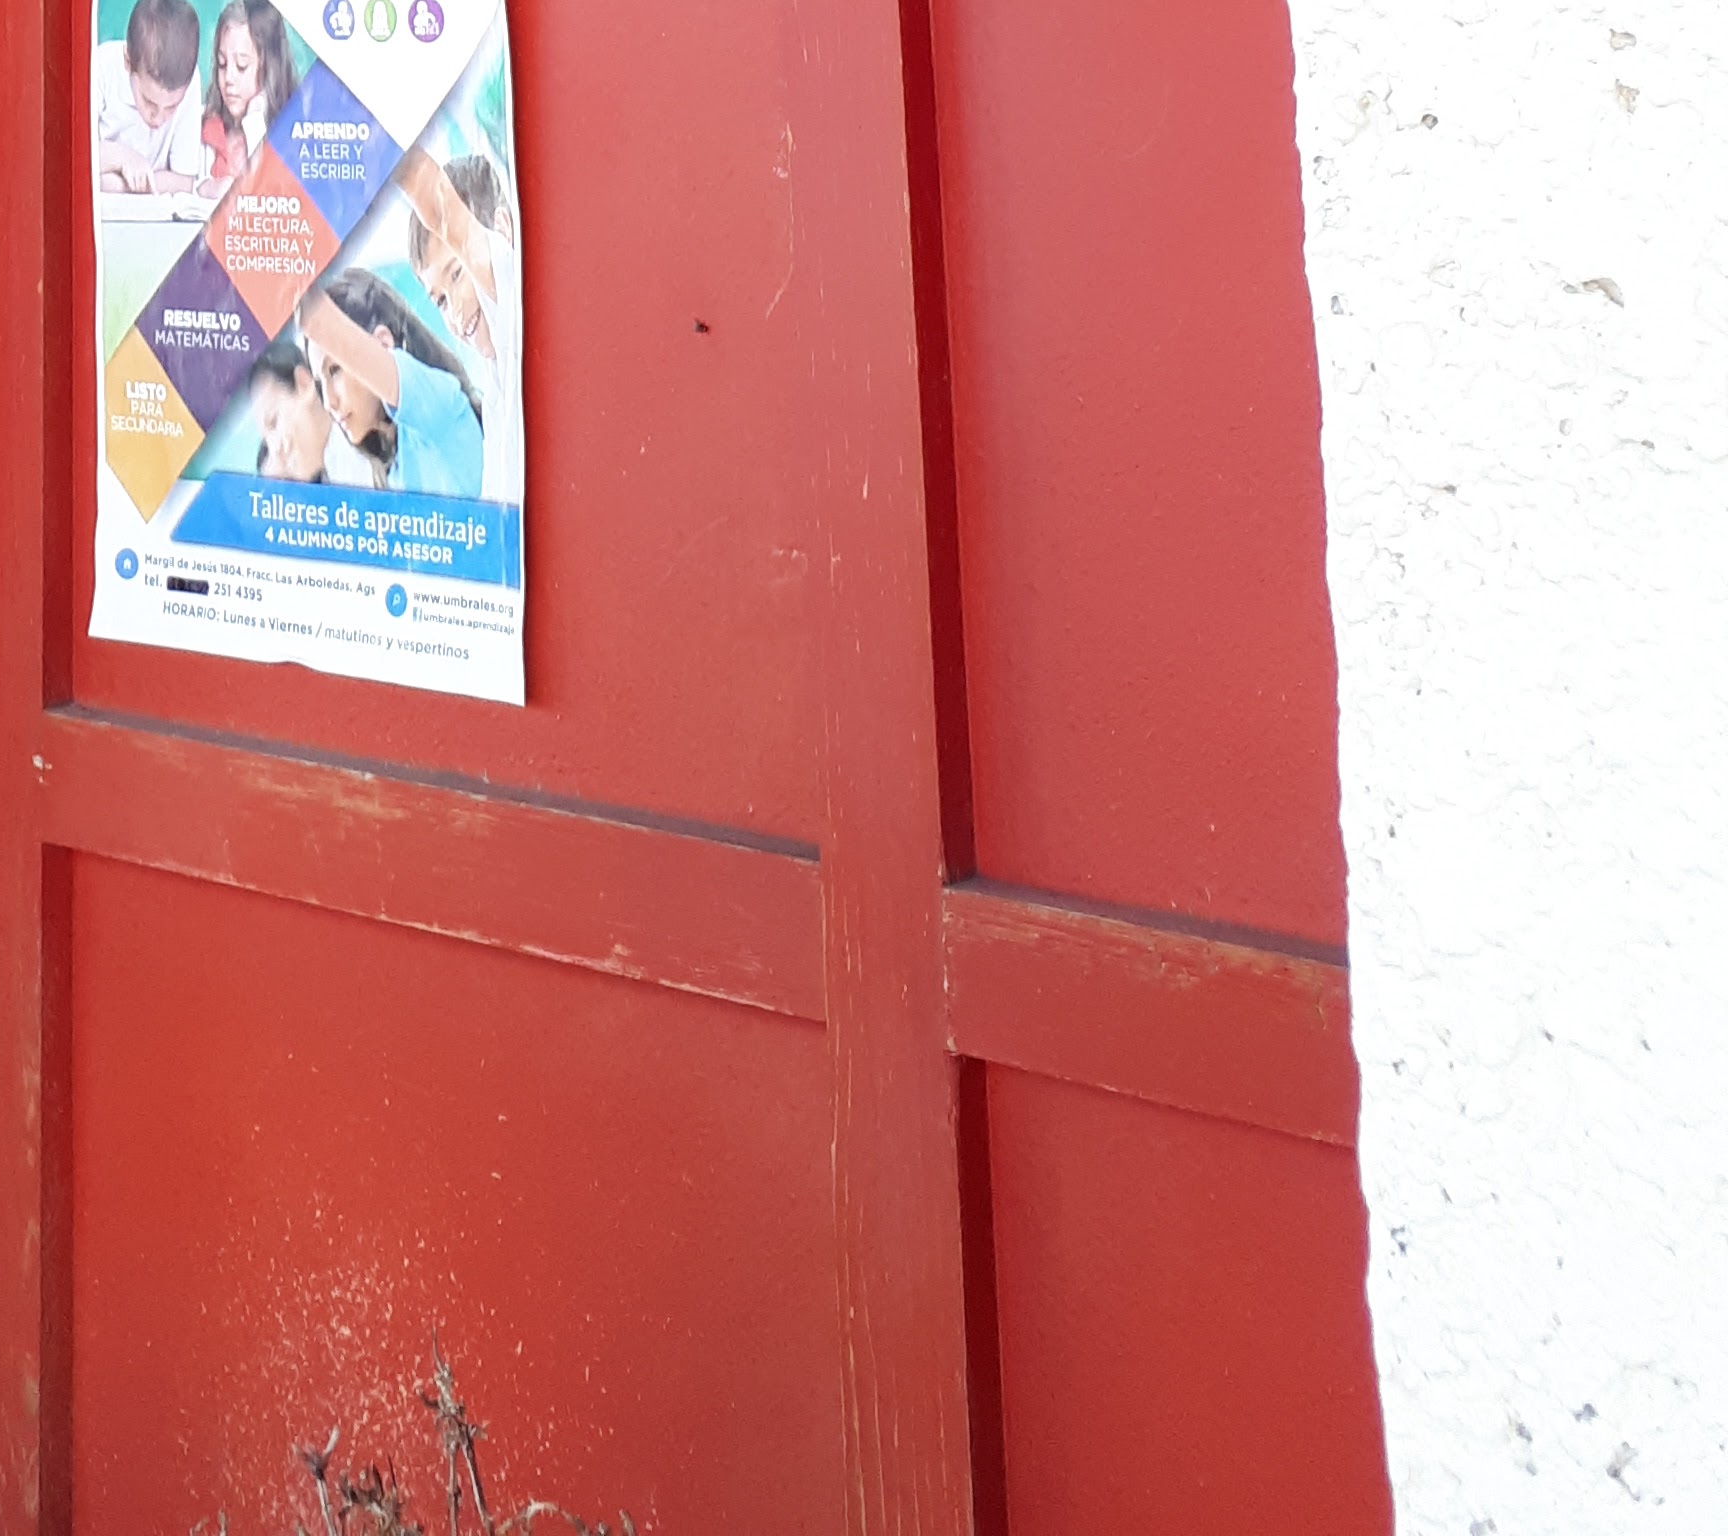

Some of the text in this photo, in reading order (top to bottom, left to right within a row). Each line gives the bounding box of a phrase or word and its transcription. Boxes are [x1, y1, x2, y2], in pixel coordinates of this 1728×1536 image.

[291, 121, 370, 141] APRENDO
[299, 143, 364, 160] A LEER Y
[301, 162, 367, 180] ESCRIBIR
[237, 195, 301, 215] MEJORO
[228, 217, 314, 237] MI LECTURA,
[224, 235, 314, 257] ESCRITURA Y
[226, 253, 316, 275] COMPRESIÓN
[163, 309, 241, 332] RESUELVO
[155, 329, 250, 352] MATEMÁTICAS
[125, 380, 167, 401] LISTO
[130, 399, 164, 418] PARA
[110, 415, 184, 437] SECUNDARIA
[248, 491, 487, 551] Talleres de aprendizaje
[264, 526, 453, 565] 4 ALUMNOS POR ASESOR
[177, 558, 189, 569] de
[275, 572, 292, 585] Las
[144, 574, 162, 587] tel.
[213, 582, 231, 597] 251
[235, 586, 263, 602] 4395
[413, 592, 514, 618] www.umbrales.org
[163, 601, 220, 622] HORARIO:
[223, 610, 256, 627] Lunes
[259, 618, 266, 629] a
[268, 618, 313, 635] Viernes
[324, 627, 382, 646] matutinos
[386, 636, 394, 650] y
[397, 637, 470, 660] vespertinos
